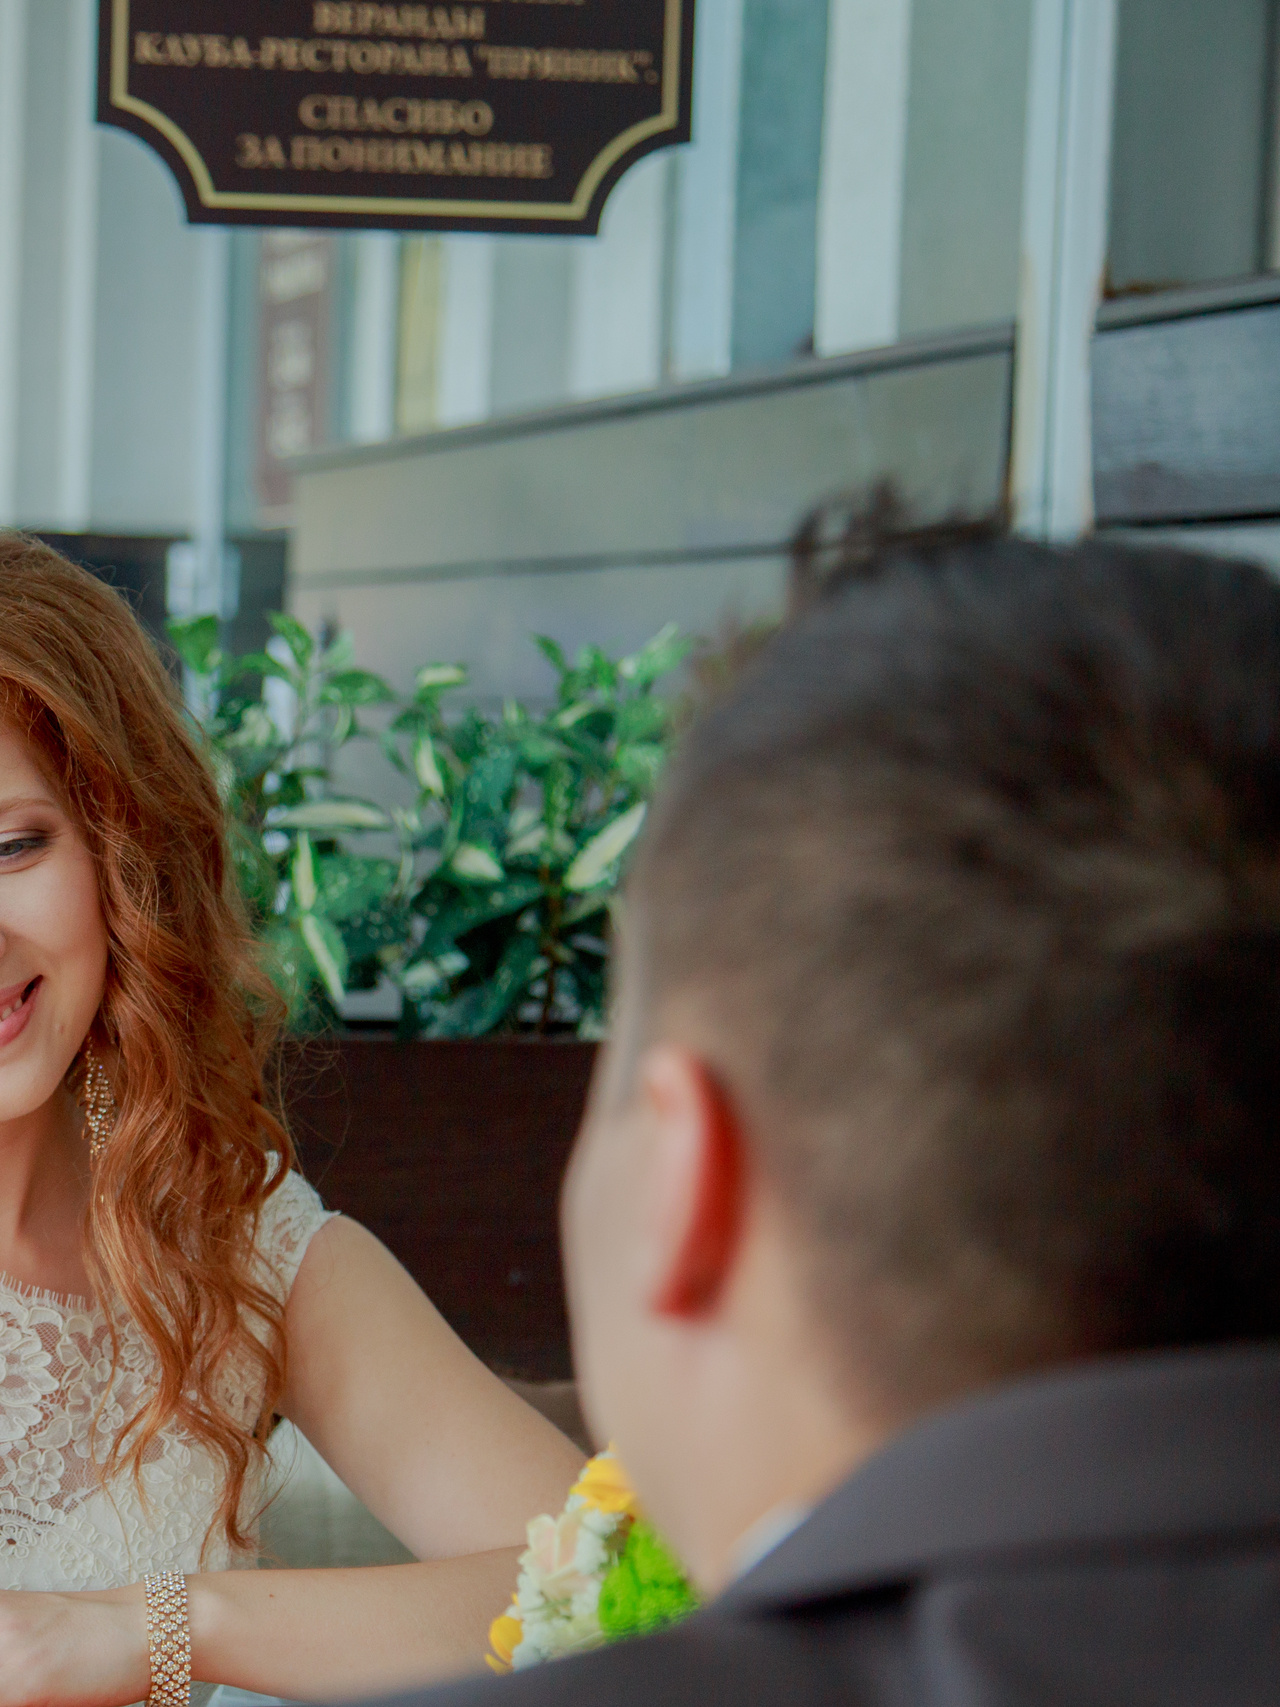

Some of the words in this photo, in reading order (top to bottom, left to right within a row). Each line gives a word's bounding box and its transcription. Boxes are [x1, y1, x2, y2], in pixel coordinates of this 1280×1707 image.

[298, 94, 494, 136] СПАСИБО
[234, 132, 287, 169] ЗА
[290, 136, 553, 179] ПОНИМАНИЕ
